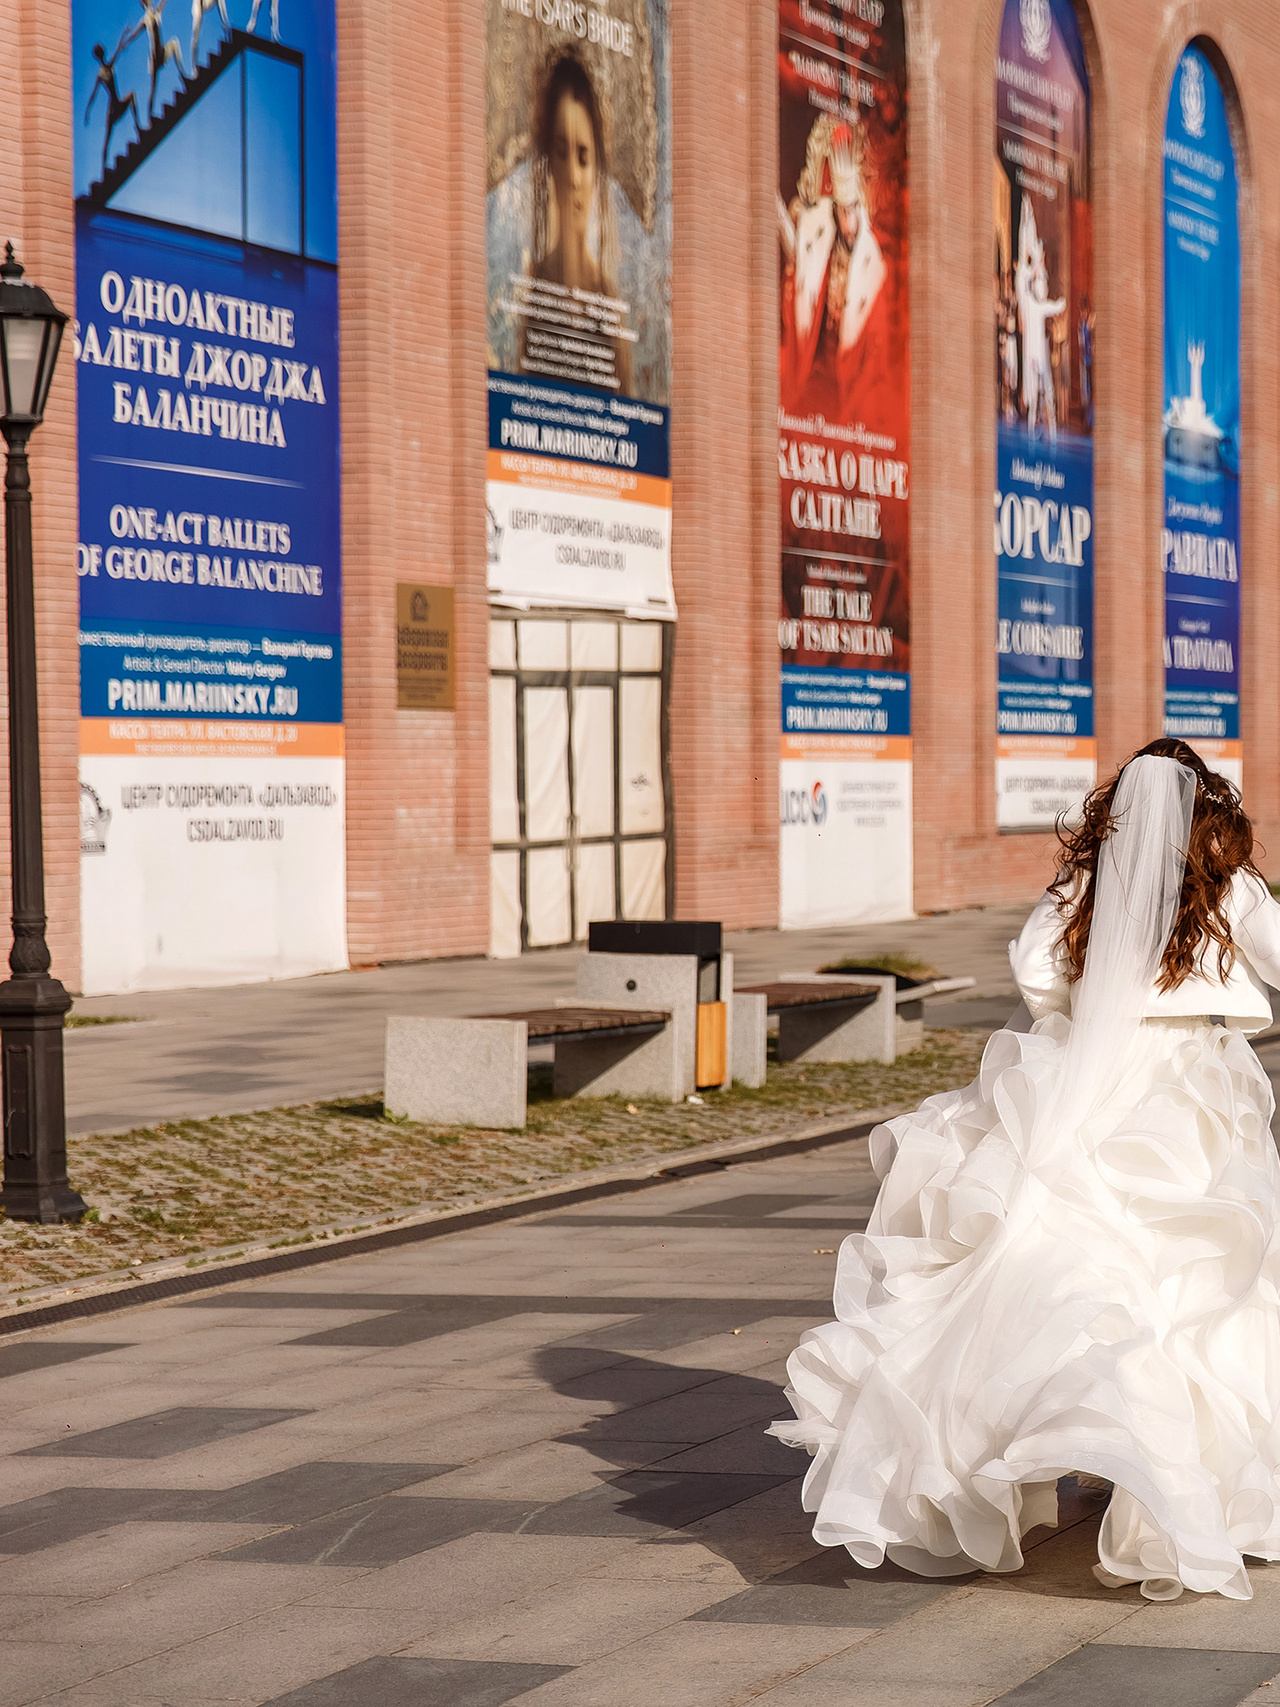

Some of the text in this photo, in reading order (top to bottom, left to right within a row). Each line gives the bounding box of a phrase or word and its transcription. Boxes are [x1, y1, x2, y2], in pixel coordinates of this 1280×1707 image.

[587, 8, 634, 58] BRIDE
[100, 270, 295, 348] ОДНОАКТНЫЕ
[184, 341, 327, 405] ДЖОРДЖА
[113, 381, 288, 448] БАЛАНЧИНА
[500, 417, 639, 469] PRIM.MARIINSKY.RU
[840, 449, 857, 491] О
[858, 453, 909, 501] ЦАРЕ
[109, 503, 291, 555] ONE-ACT BALLETS
[790, 486, 882, 540] САЛТАНЕ
[105, 546, 195, 585] GEORGE
[196, 552, 324, 596] BALANCHINE
[801, 584, 834, 619] THE
[778, 616, 801, 650] OF
[107, 677, 299, 716] PRIM.MARIINSKY.RU
